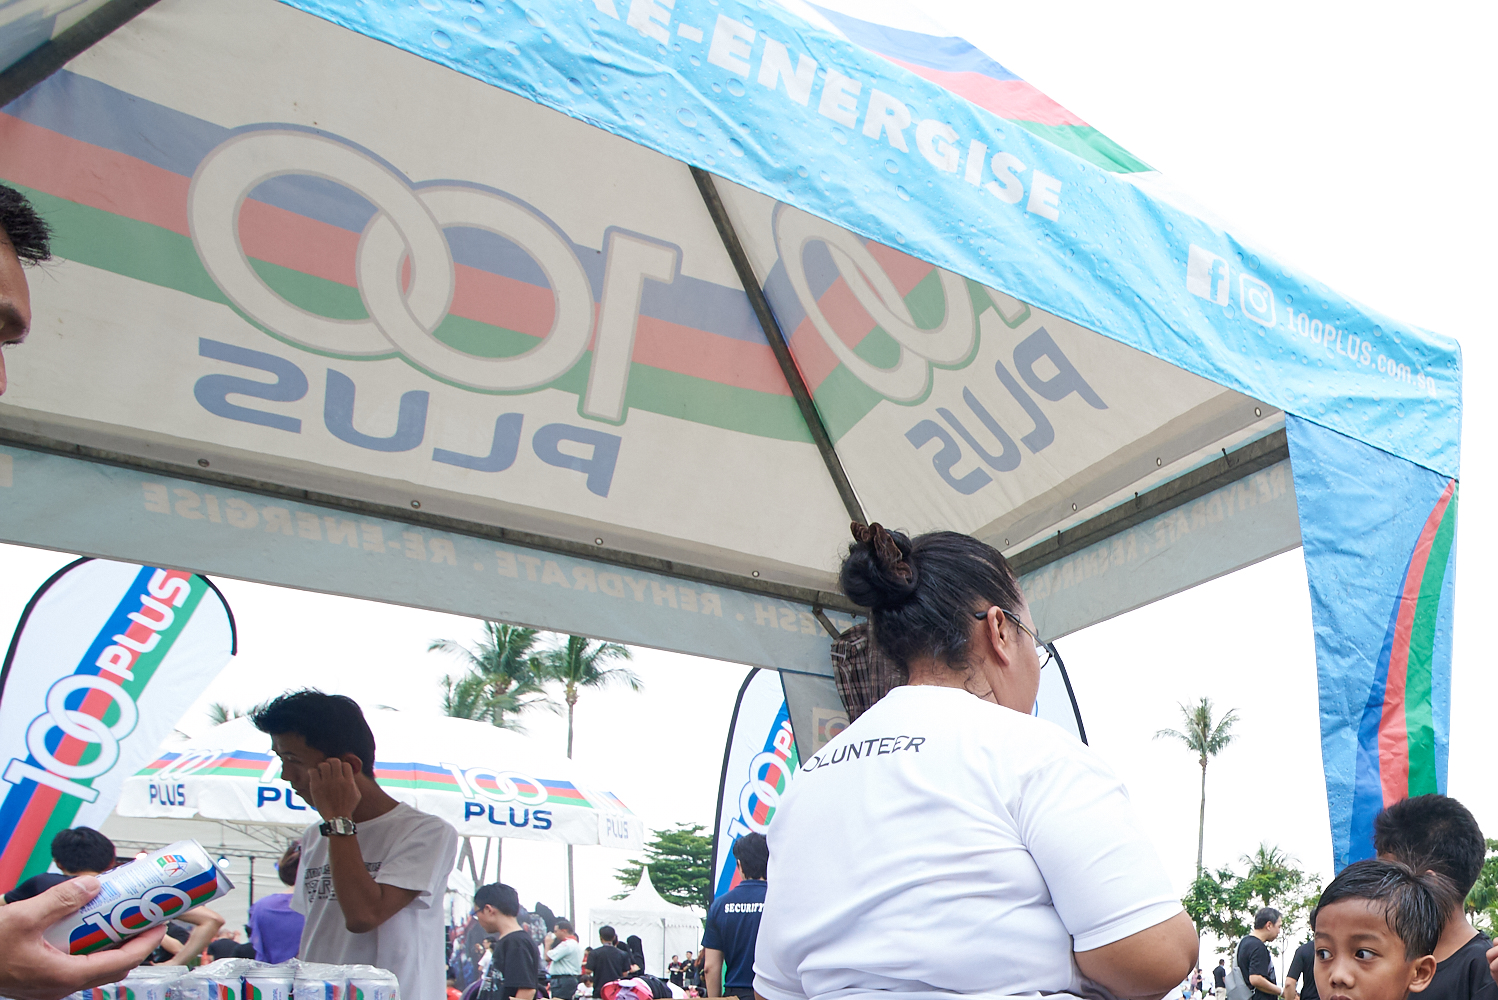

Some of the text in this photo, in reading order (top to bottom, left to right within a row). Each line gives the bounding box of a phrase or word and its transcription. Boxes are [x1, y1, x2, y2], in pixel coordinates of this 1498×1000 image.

[593, 0, 1062, 222] E-ENERGISE
[1286, 307, 1437, 398] 100PLUS.com.sg
[95, 568, 192, 682] PLUS
[2, 673, 139, 803] 100
[803, 735, 926, 773] OLUNTEER
[150, 784, 186, 806] PLUS
[257, 786, 318, 812] PL
[439, 762, 549, 806] 100
[464, 801, 552, 830] PLUS
[606, 818, 629, 839] PLUS
[82, 885, 192, 943] 100
